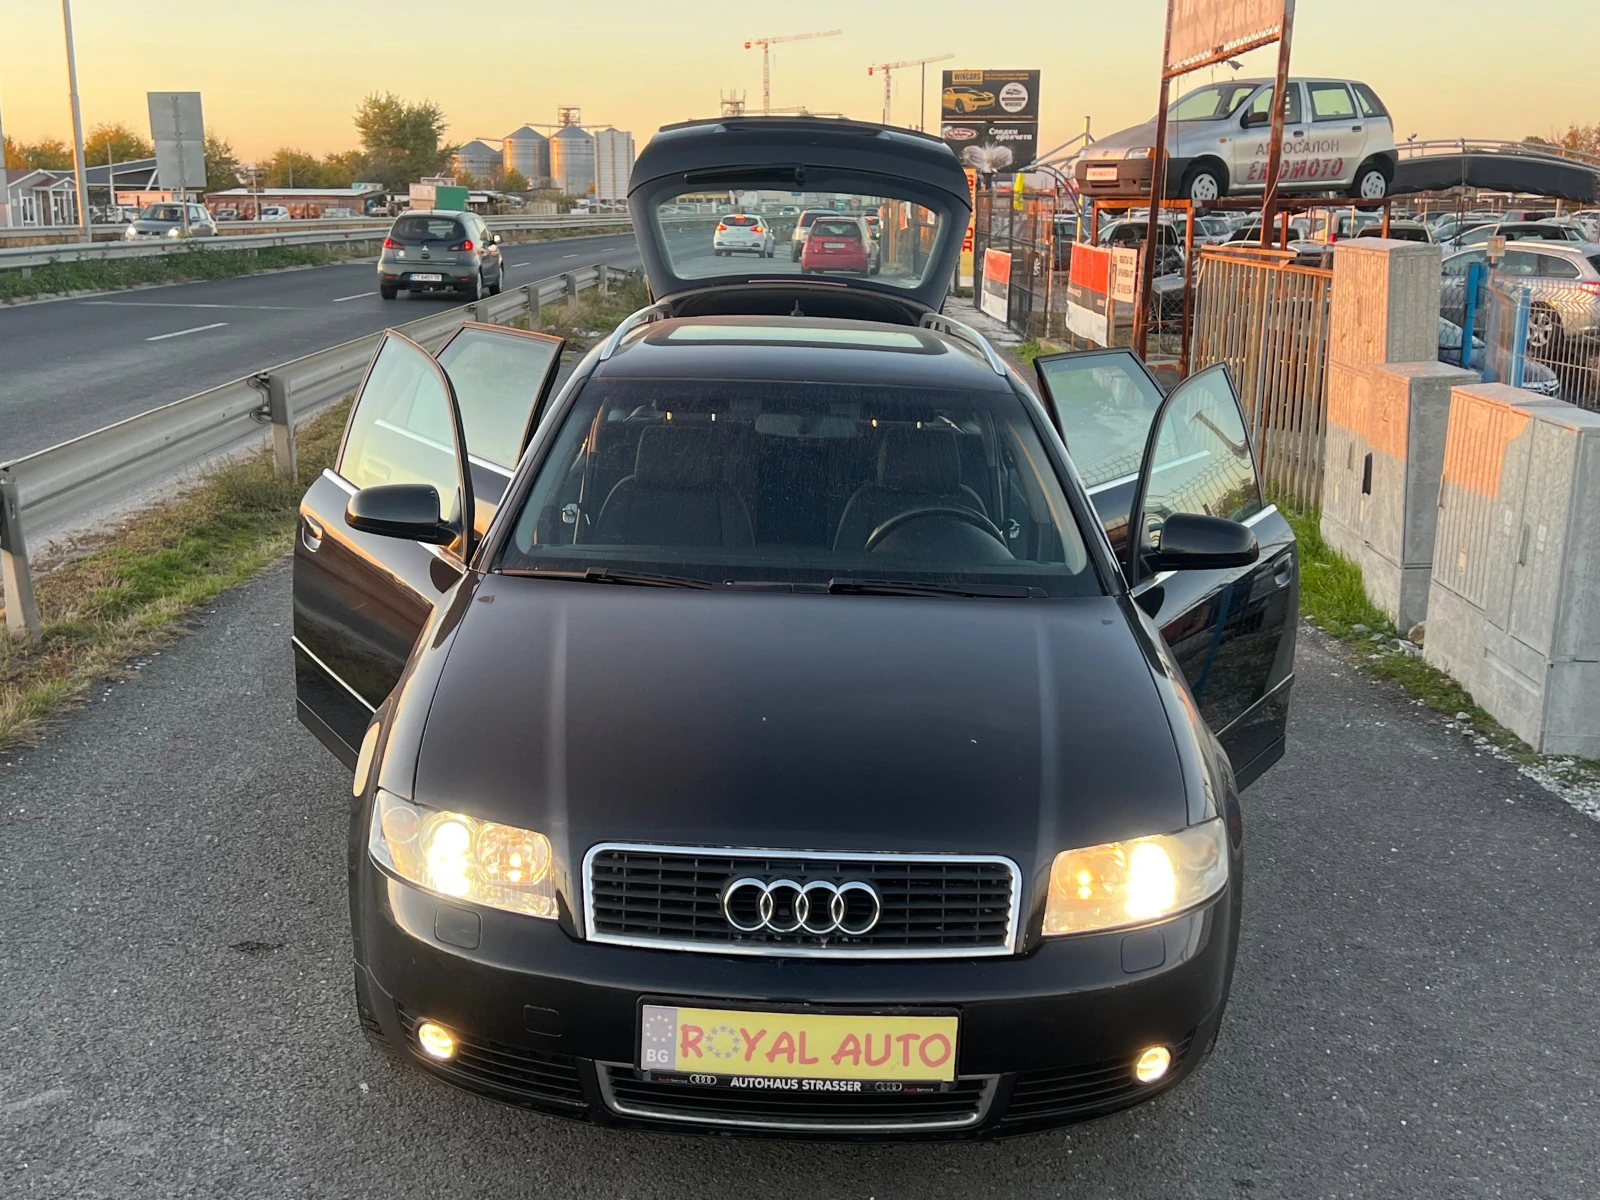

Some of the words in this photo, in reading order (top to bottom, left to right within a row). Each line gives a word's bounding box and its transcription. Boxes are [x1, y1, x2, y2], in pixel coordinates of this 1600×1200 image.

[1255, 140, 1340, 156] АОСАЛОН
[646, 1049, 669, 1063] BG
[831, 1033, 951, 1067] AUTO
[730, 1077, 798, 1090] AUTOHAUS
[802, 1079, 861, 1092] STRASSER
